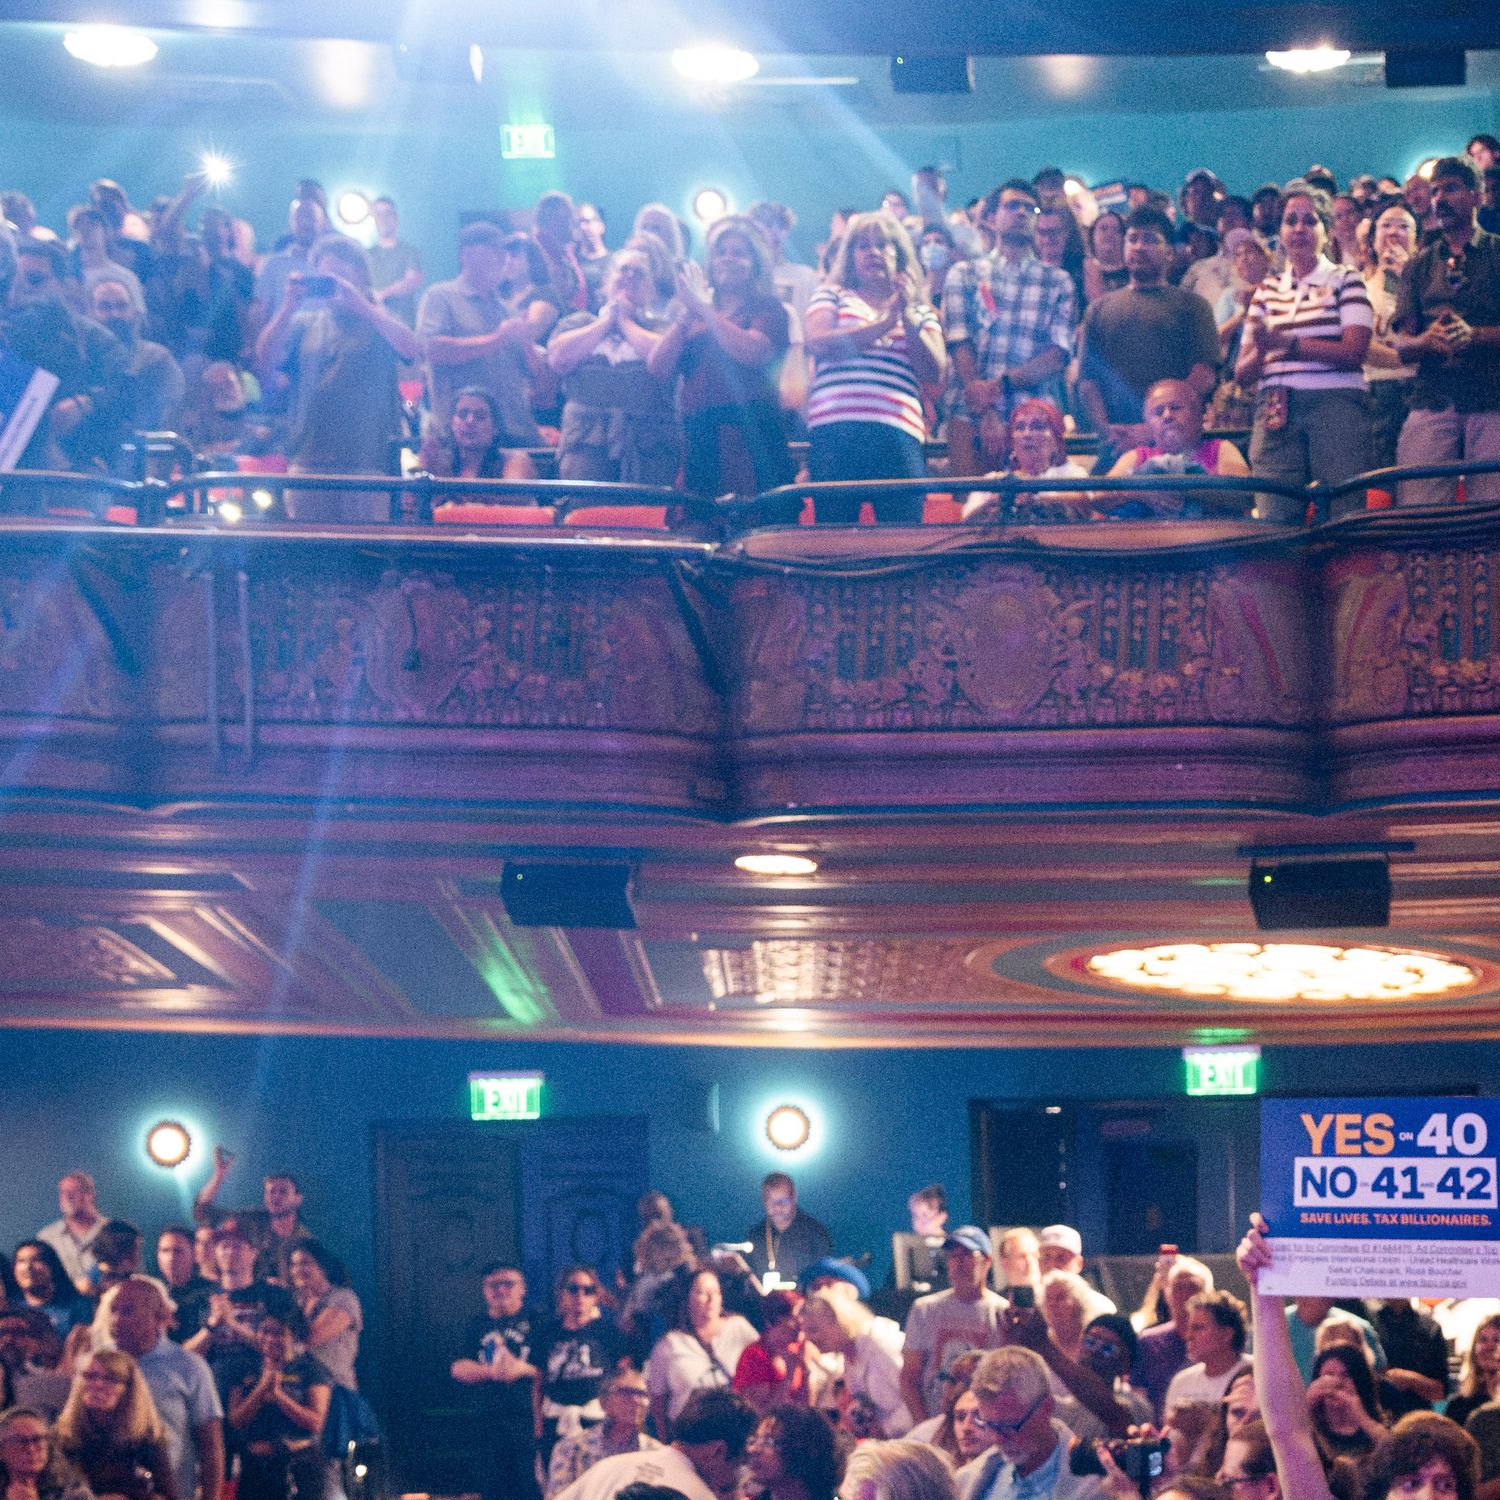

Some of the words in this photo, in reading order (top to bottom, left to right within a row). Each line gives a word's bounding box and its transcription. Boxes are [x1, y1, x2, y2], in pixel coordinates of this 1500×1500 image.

[1300, 1113, 1395, 1155] YES
[1399, 1131, 1413, 1141] ON
[1417, 1113, 1488, 1156] 40
[1301, 1166, 1357, 1198] NO
[1371, 1166, 1425, 1199] 41
[1436, 1167, 1491, 1200] 42
[1300, 1213, 1331, 1224] SAVE
[1334, 1213, 1371, 1225] LIVES.
[1373, 1214, 1400, 1225] TAX
[1401, 1214, 1491, 1226] BILLIONAIRES.
